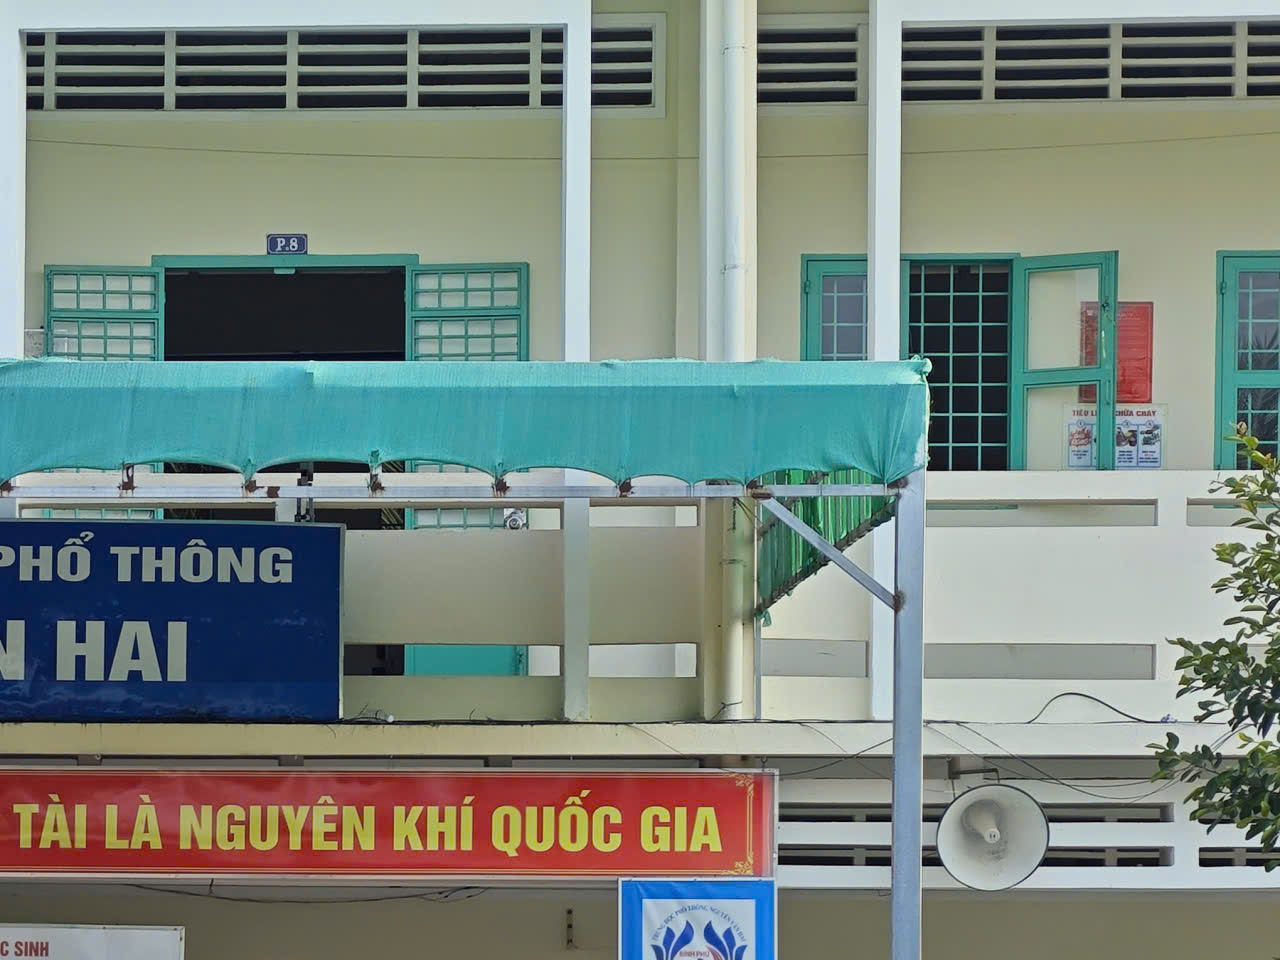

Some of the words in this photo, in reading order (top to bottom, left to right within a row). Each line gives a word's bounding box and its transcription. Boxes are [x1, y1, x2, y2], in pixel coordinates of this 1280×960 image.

[276, 238, 299, 252] P.8
[110, 538, 294, 584] THÔNG
[55, 620, 189, 682] HAI
[13, 794, 88, 849] TÀI
[105, 794, 163, 850] LÀ
[178, 795, 376, 851] NGUYÊN
[392, 795, 475, 851] KHÍ
[491, 789, 622, 858] QUỐC
[639, 806, 723, 853] GIA
[14, 941, 50, 957] SINH
